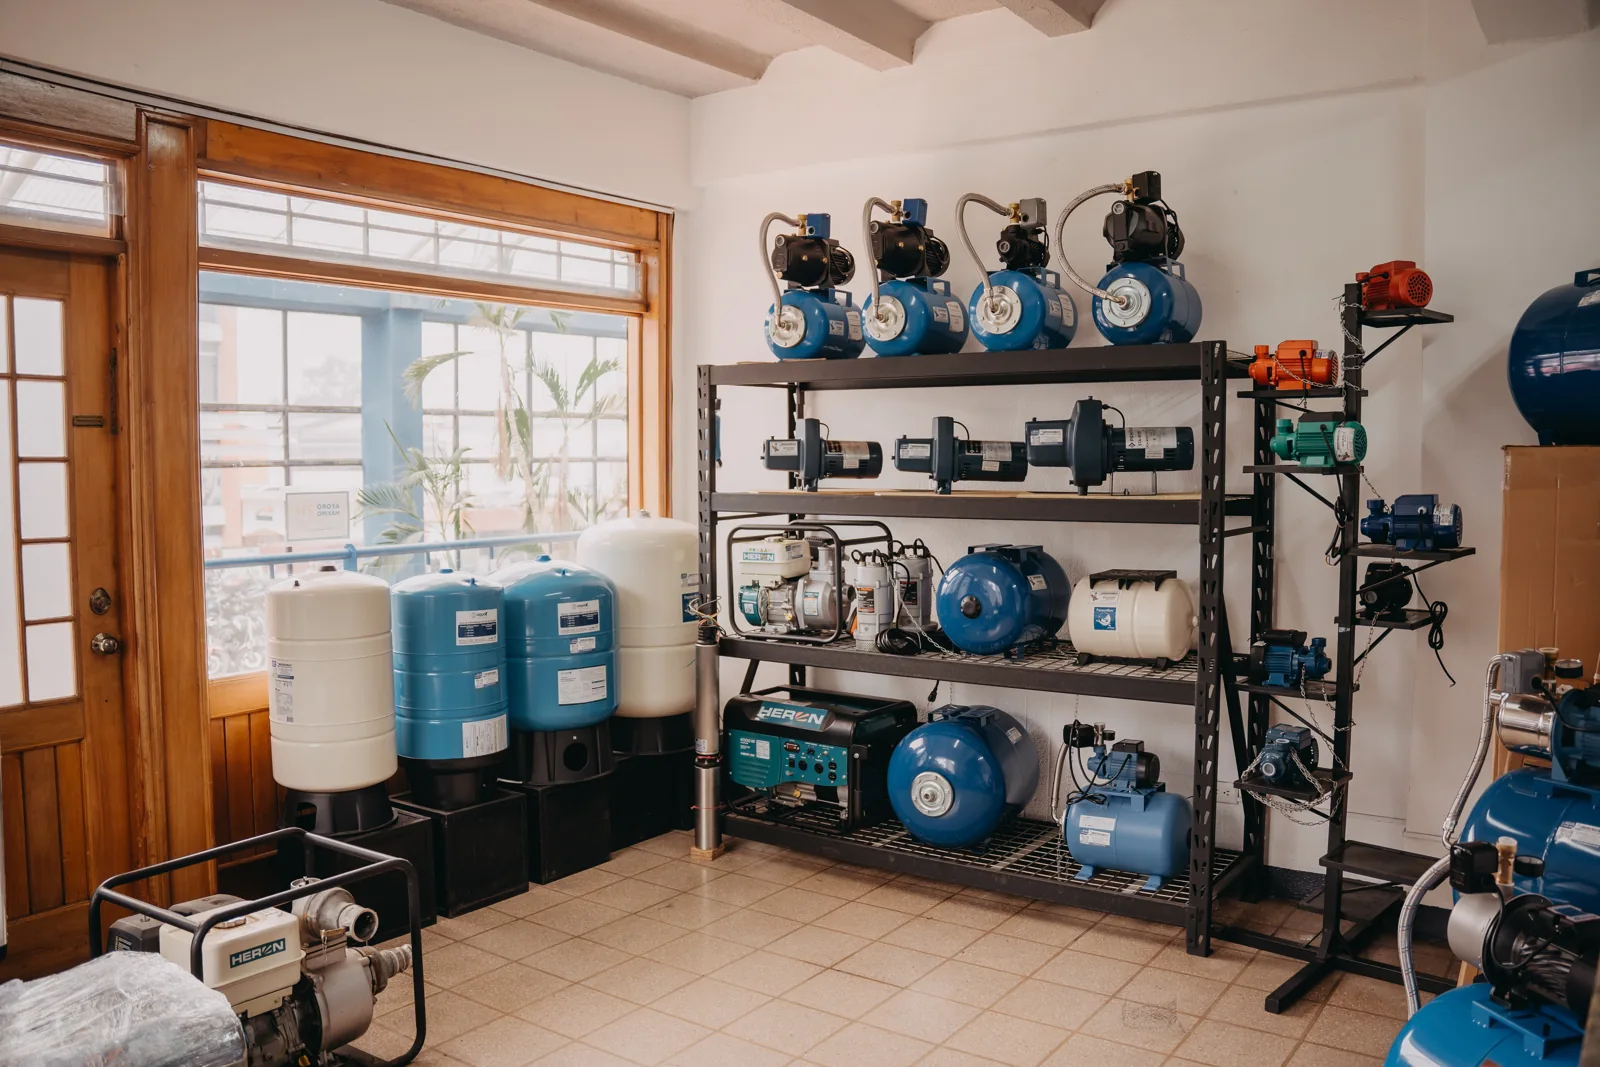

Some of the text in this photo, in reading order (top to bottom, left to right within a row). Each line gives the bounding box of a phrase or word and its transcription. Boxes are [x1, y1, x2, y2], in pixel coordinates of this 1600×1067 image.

[743, 552, 774, 561] HERON
[757, 706, 824, 724] HERON
[231, 940, 284, 966] HERON
